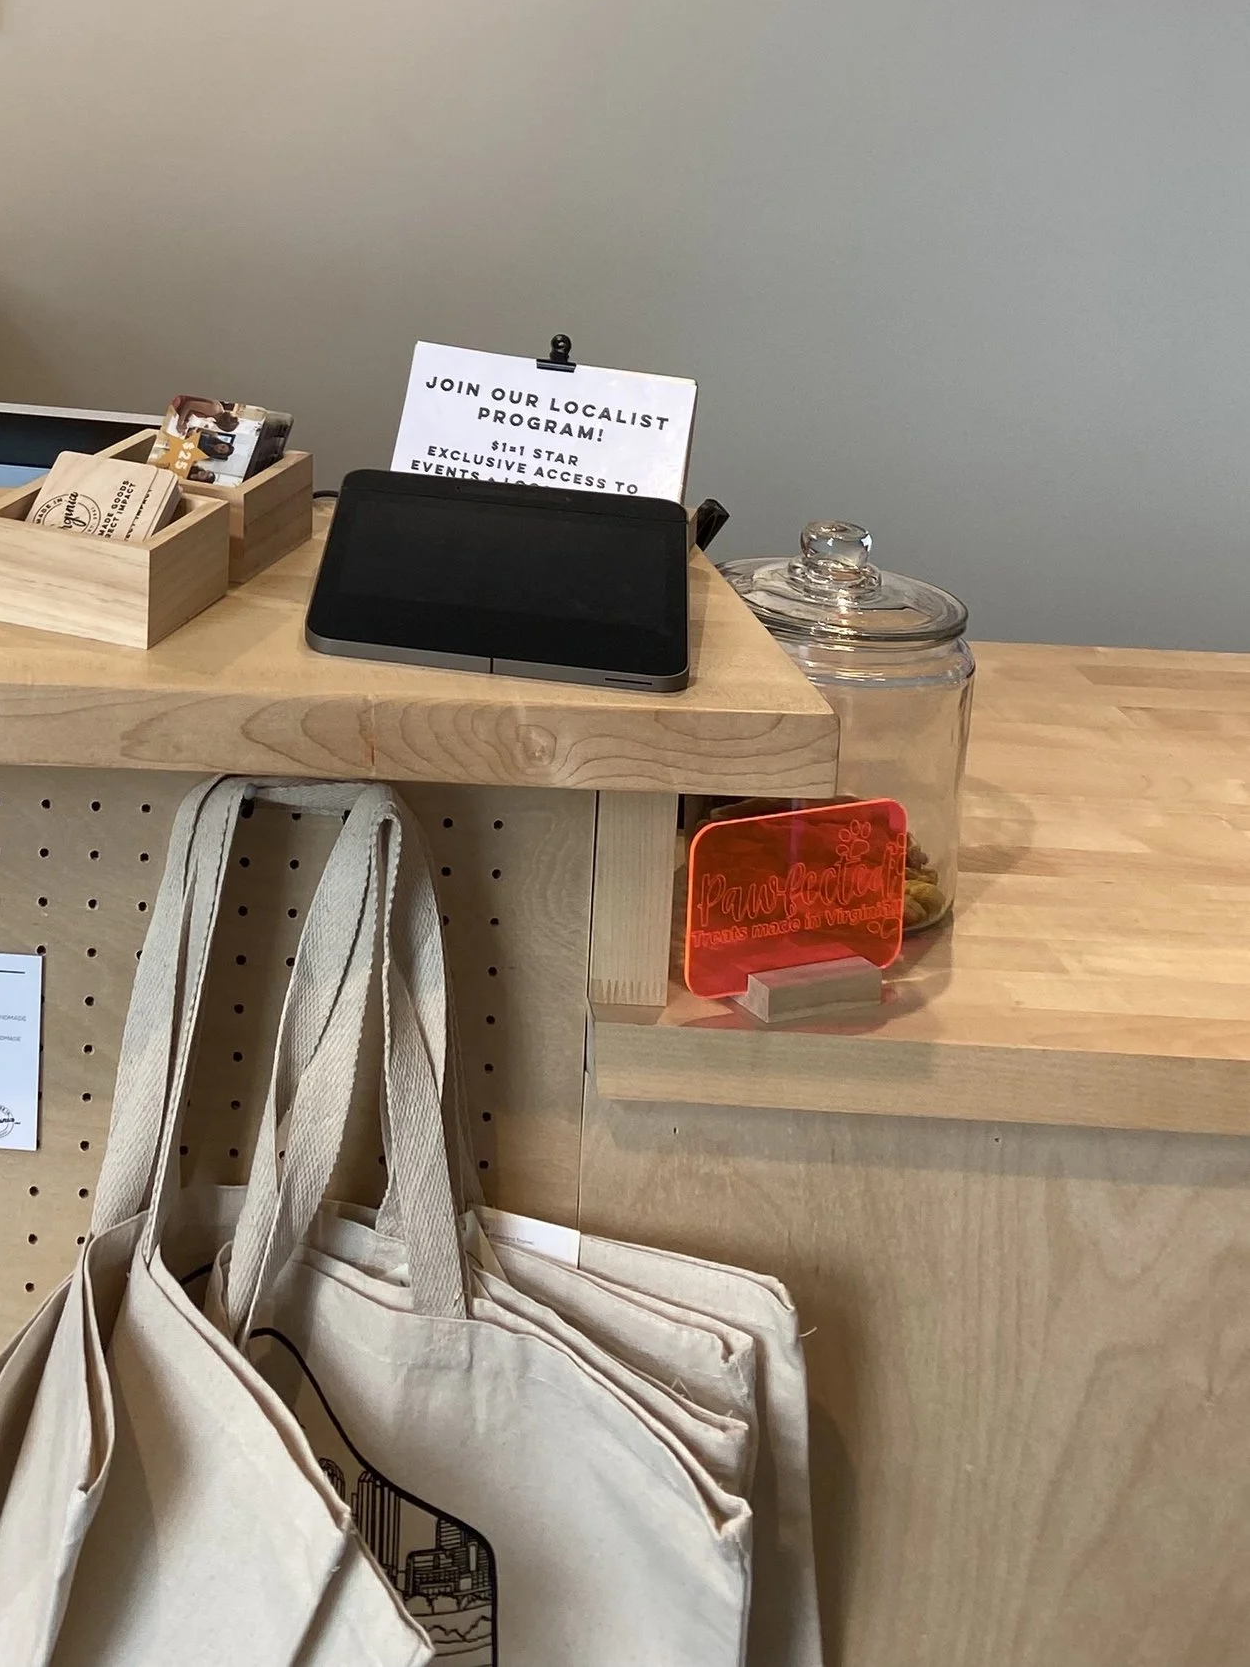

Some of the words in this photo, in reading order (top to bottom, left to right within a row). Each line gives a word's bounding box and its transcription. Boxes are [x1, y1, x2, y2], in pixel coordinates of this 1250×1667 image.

[425, 376, 480, 397] JOIN
[491, 387, 539, 408] OUR
[550, 398, 669, 431] LOCALIST
[477, 407, 604, 442] PROGRAM!
[175, 441, 196, 470] $25
[491, 440, 525, 456] $1=1
[533, 449, 578, 466] STAR
[411, 459, 479, 481] EVENTS
[427, 445, 527, 474] EXCLUSIVE
[533, 466, 606, 489] ACCESS
[615, 481, 638, 495] TO
[98, 512, 114, 536] MADE
[111, 480, 129, 510] GOODS
[117, 482, 136, 515] IMPACT
[805, 912, 820, 930] in
